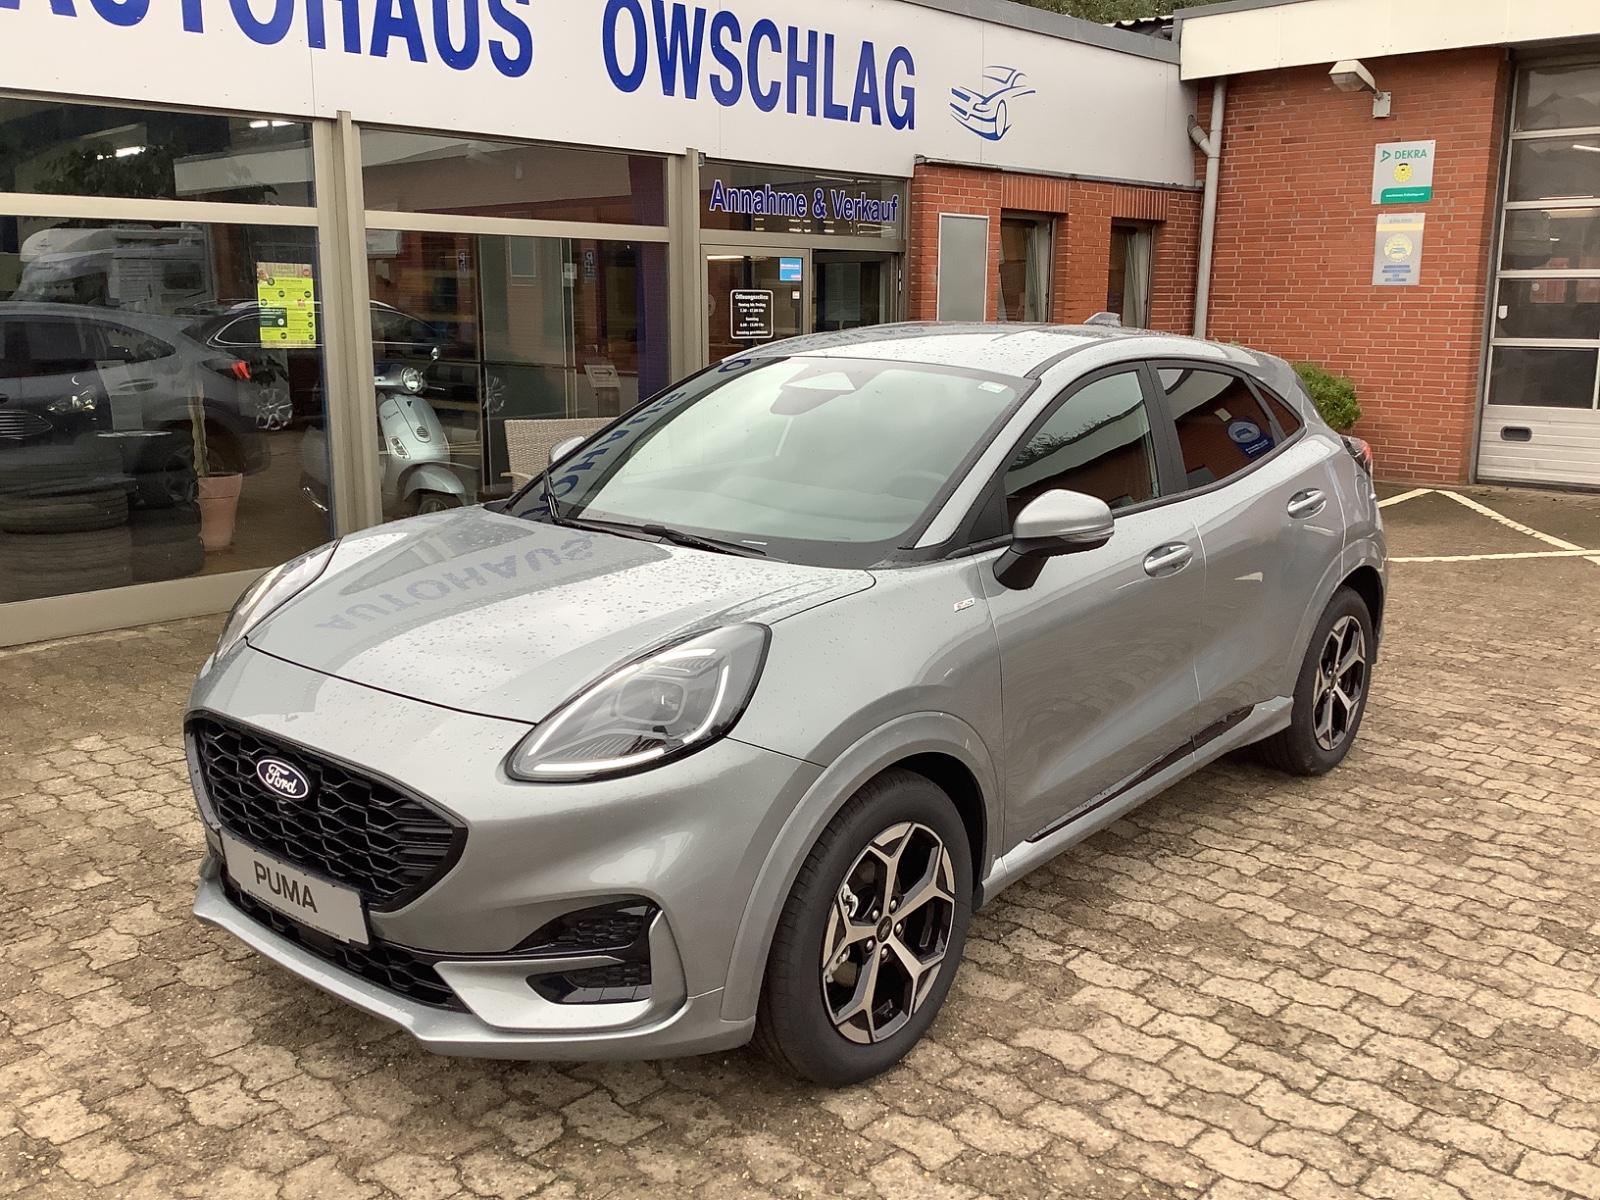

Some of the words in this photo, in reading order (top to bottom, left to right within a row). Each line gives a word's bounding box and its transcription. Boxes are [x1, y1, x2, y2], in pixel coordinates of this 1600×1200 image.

[0, 0, 533, 78] HAUS
[602, 0, 916, 131] OWSCHLAG
[1394, 149, 1428, 160] DEKRA
[709, 178, 807, 218] Annahme
[812, 187, 827, 220] &
[830, 188, 899, 223] Verkauf
[265, 764, 298, 794] Ford
[253, 860, 318, 914] PUMA
